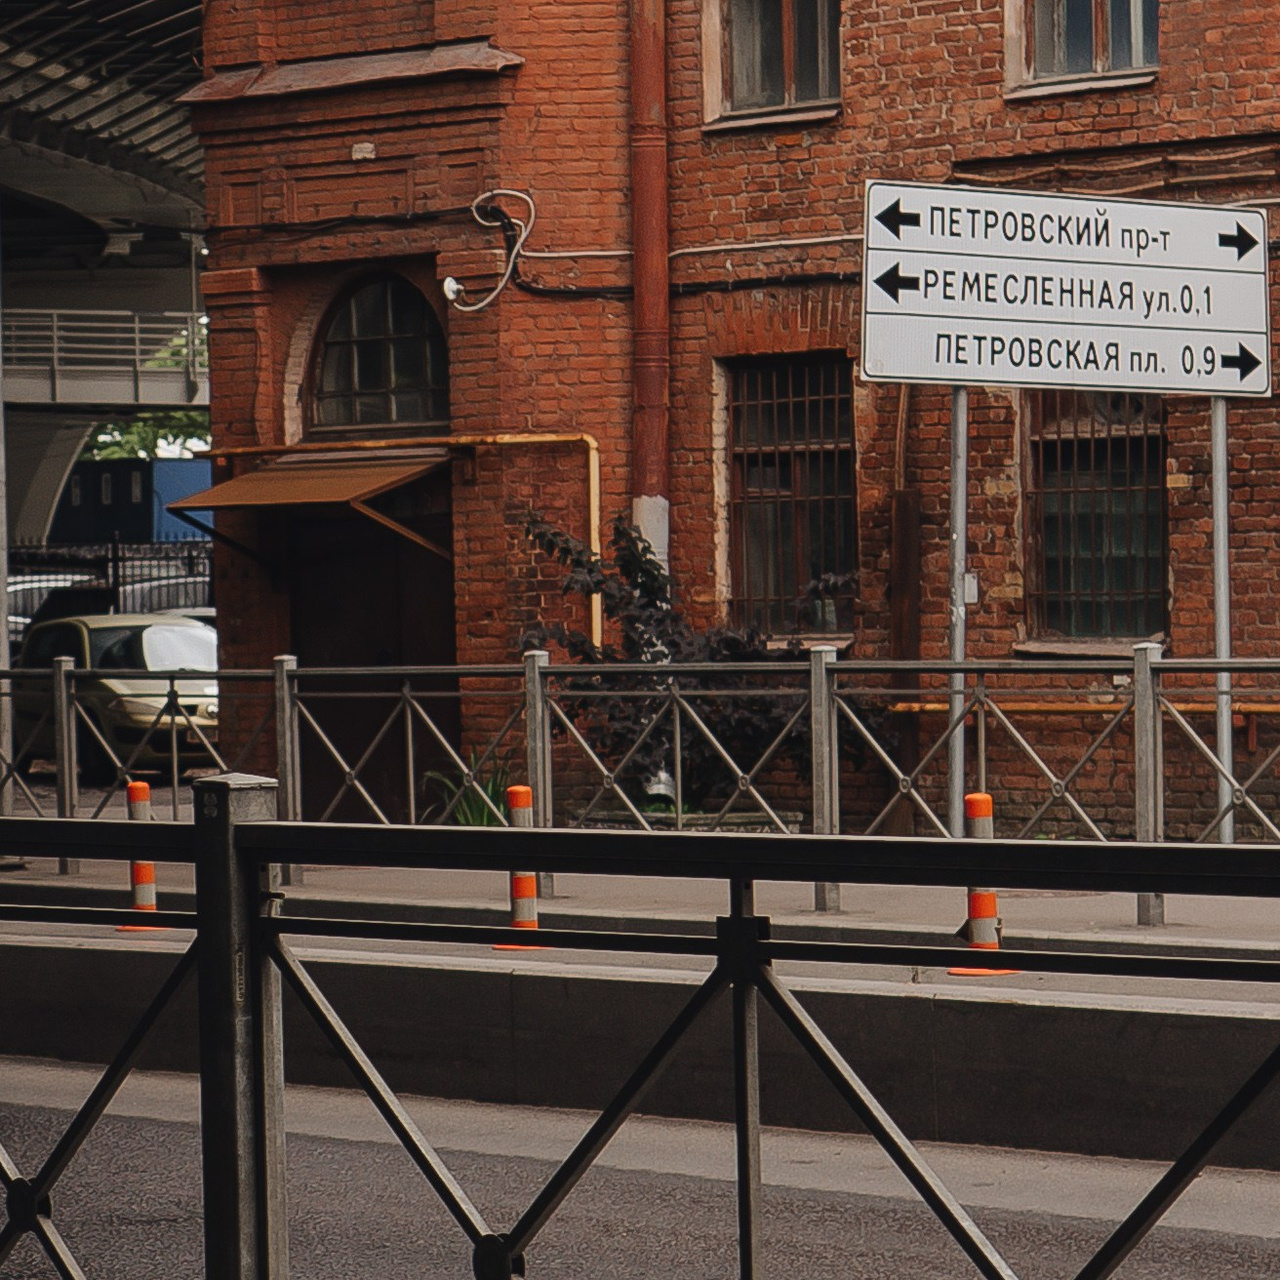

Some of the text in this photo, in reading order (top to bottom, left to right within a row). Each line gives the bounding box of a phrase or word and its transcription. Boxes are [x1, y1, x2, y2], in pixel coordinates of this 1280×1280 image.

[930, 206, 1171, 257] ПЕТРОВСКИЙ пр-т
[923, 269, 1134, 310] РЕМЕСЛЕННАЯ
[935, 333, 1216, 376] ПЕТРОВСКАЯ пл. 0,9
